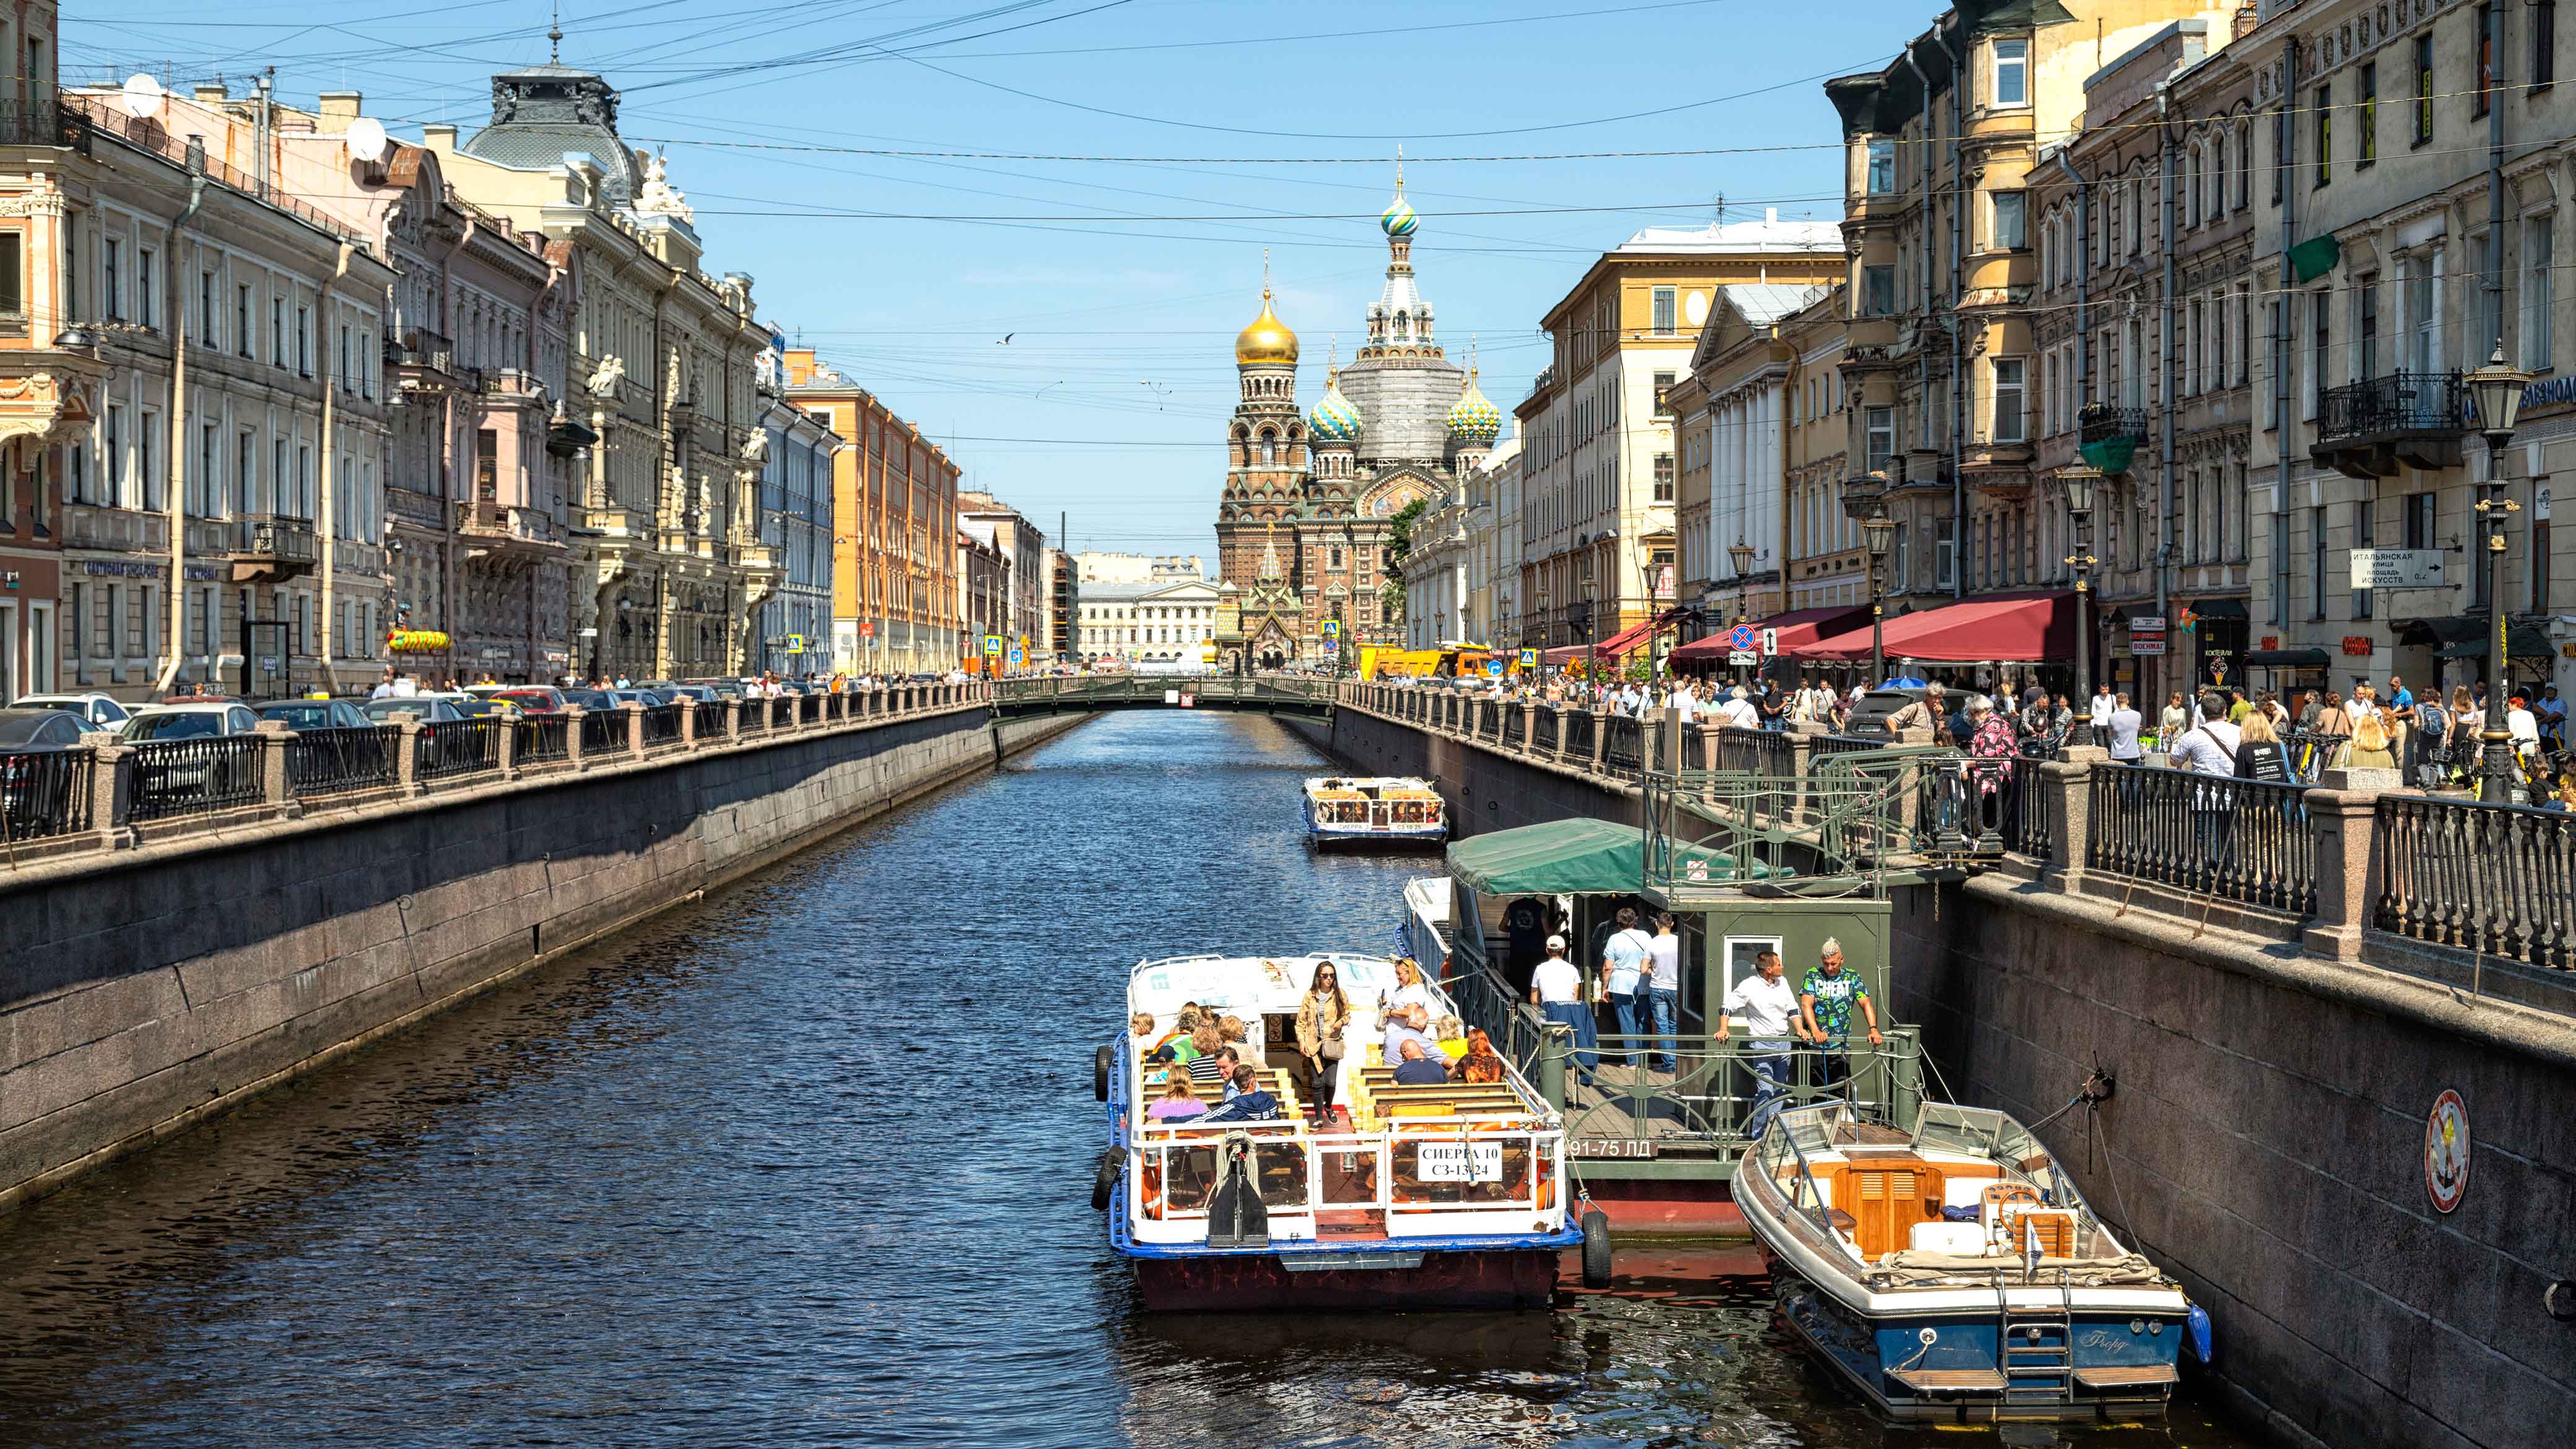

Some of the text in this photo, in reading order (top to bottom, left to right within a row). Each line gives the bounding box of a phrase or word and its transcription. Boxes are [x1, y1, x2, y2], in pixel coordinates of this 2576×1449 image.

[2343, 637, 2372, 655] СУВЕНИРЫ
[2561, 643, 2576, 657] СТО
[1815, 980, 1851, 997] CHEAT
[1422, 1148, 1498, 1159] СИЕРРА 10
[1570, 1141, 1651, 1157] 91-75 ЛД
